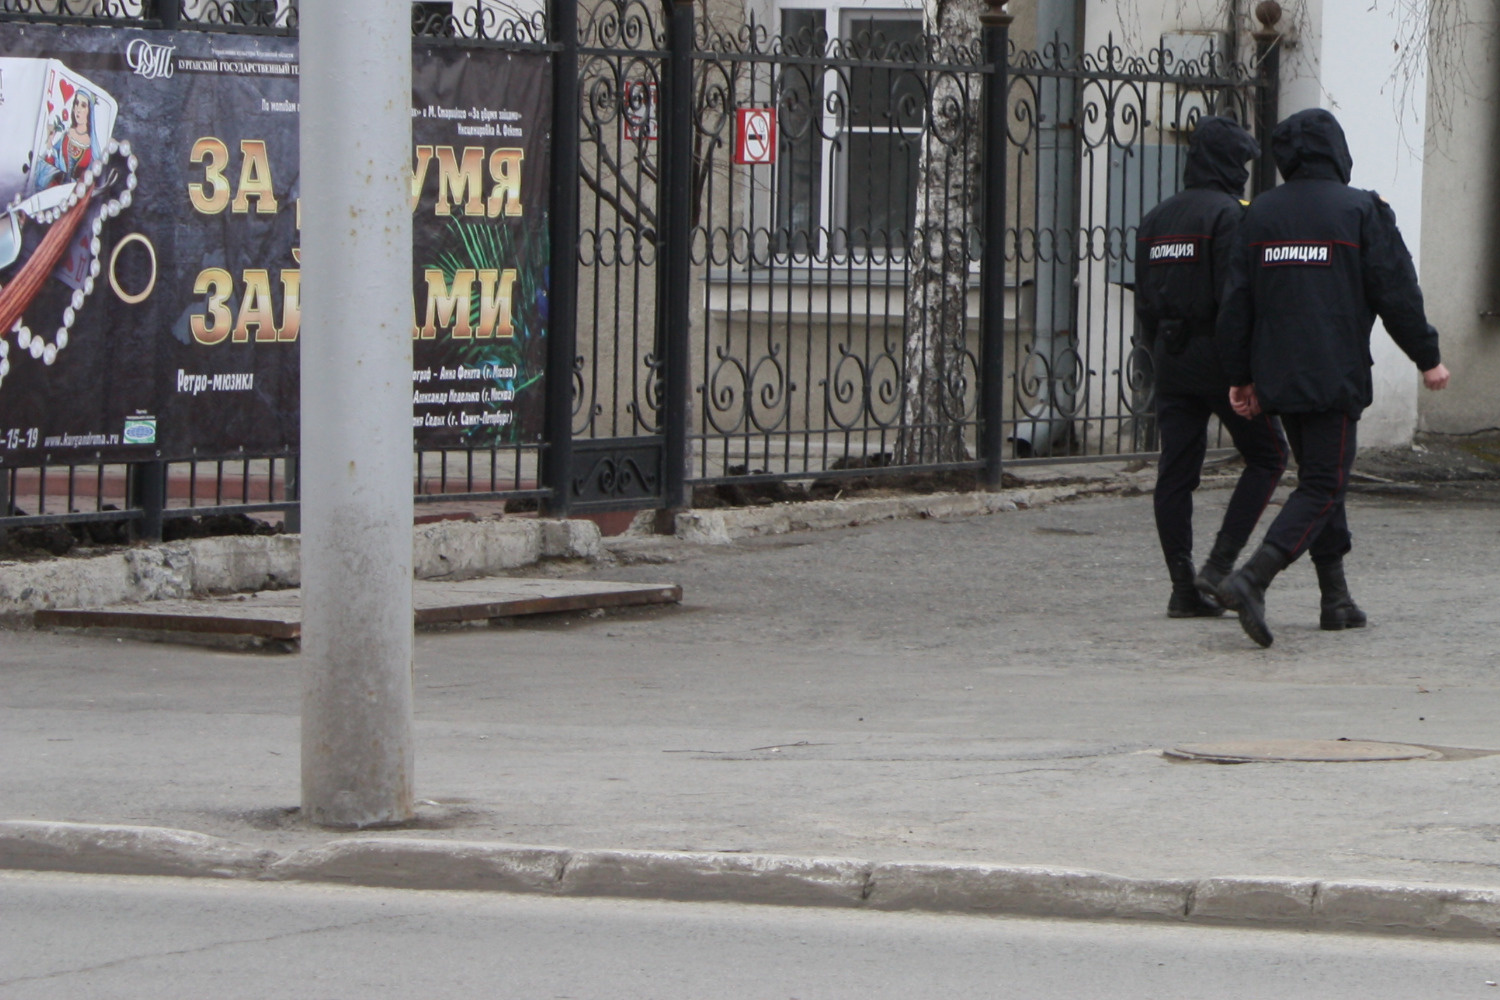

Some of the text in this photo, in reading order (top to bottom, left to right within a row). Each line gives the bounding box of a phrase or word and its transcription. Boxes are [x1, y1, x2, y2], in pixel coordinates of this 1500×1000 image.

[219, 61, 291, 75] ГОСУДАРСТВЕННЫЙ
[188, 136, 278, 215] ЗА
[1150, 243, 1194, 260] ПОЛИЦИЯ
[1264, 246, 1328, 263] ПОЛИЦИЯ
[177, 368, 254, 396] Ретро-мюзикл
[413, 366, 432, 382] ограф
[440, 365, 456, 380] Анна
[0, 427, 39, 449] -15-19
